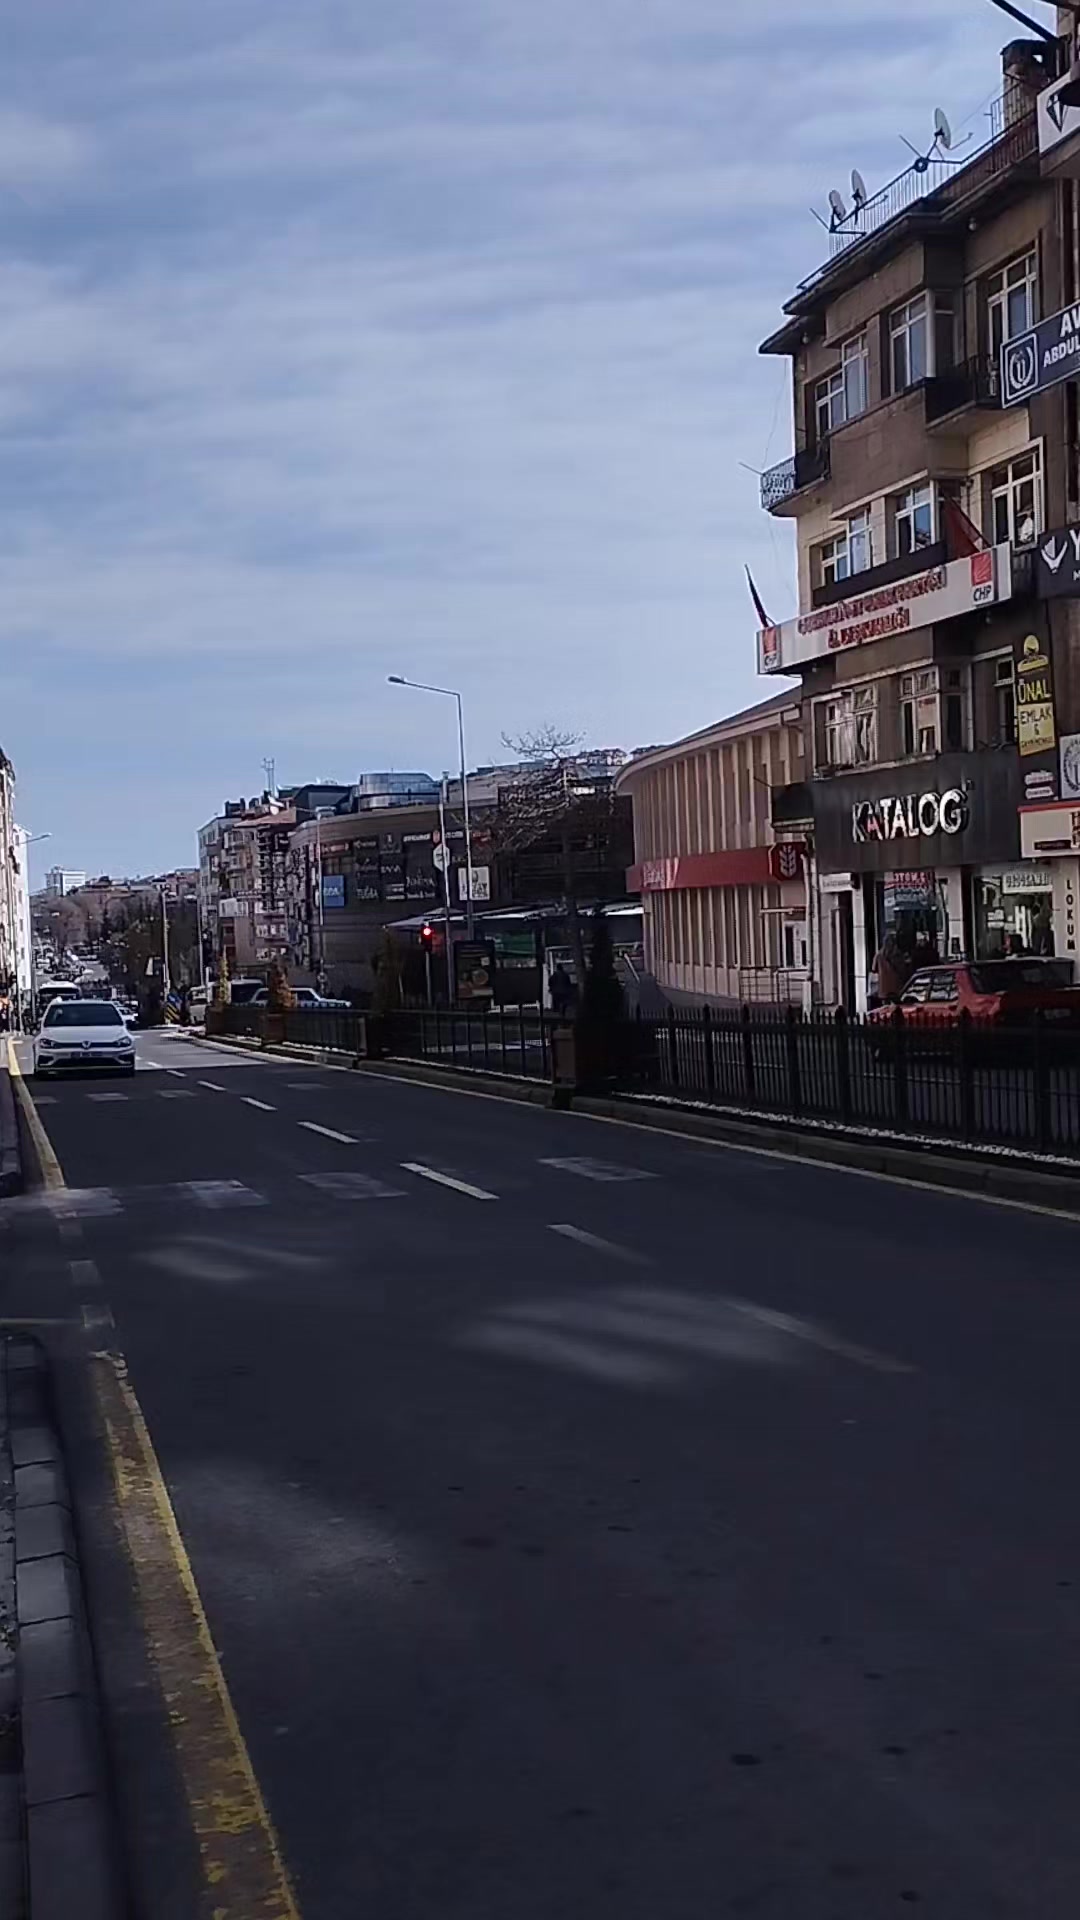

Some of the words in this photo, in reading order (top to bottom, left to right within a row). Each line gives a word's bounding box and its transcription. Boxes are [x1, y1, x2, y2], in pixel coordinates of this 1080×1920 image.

[973, 584, 992, 602] CHP
[1020, 706, 1052, 725] EMLAK
[852, 788, 965, 843] KATALOG
[1065, 879, 1076, 951] LOKUM
